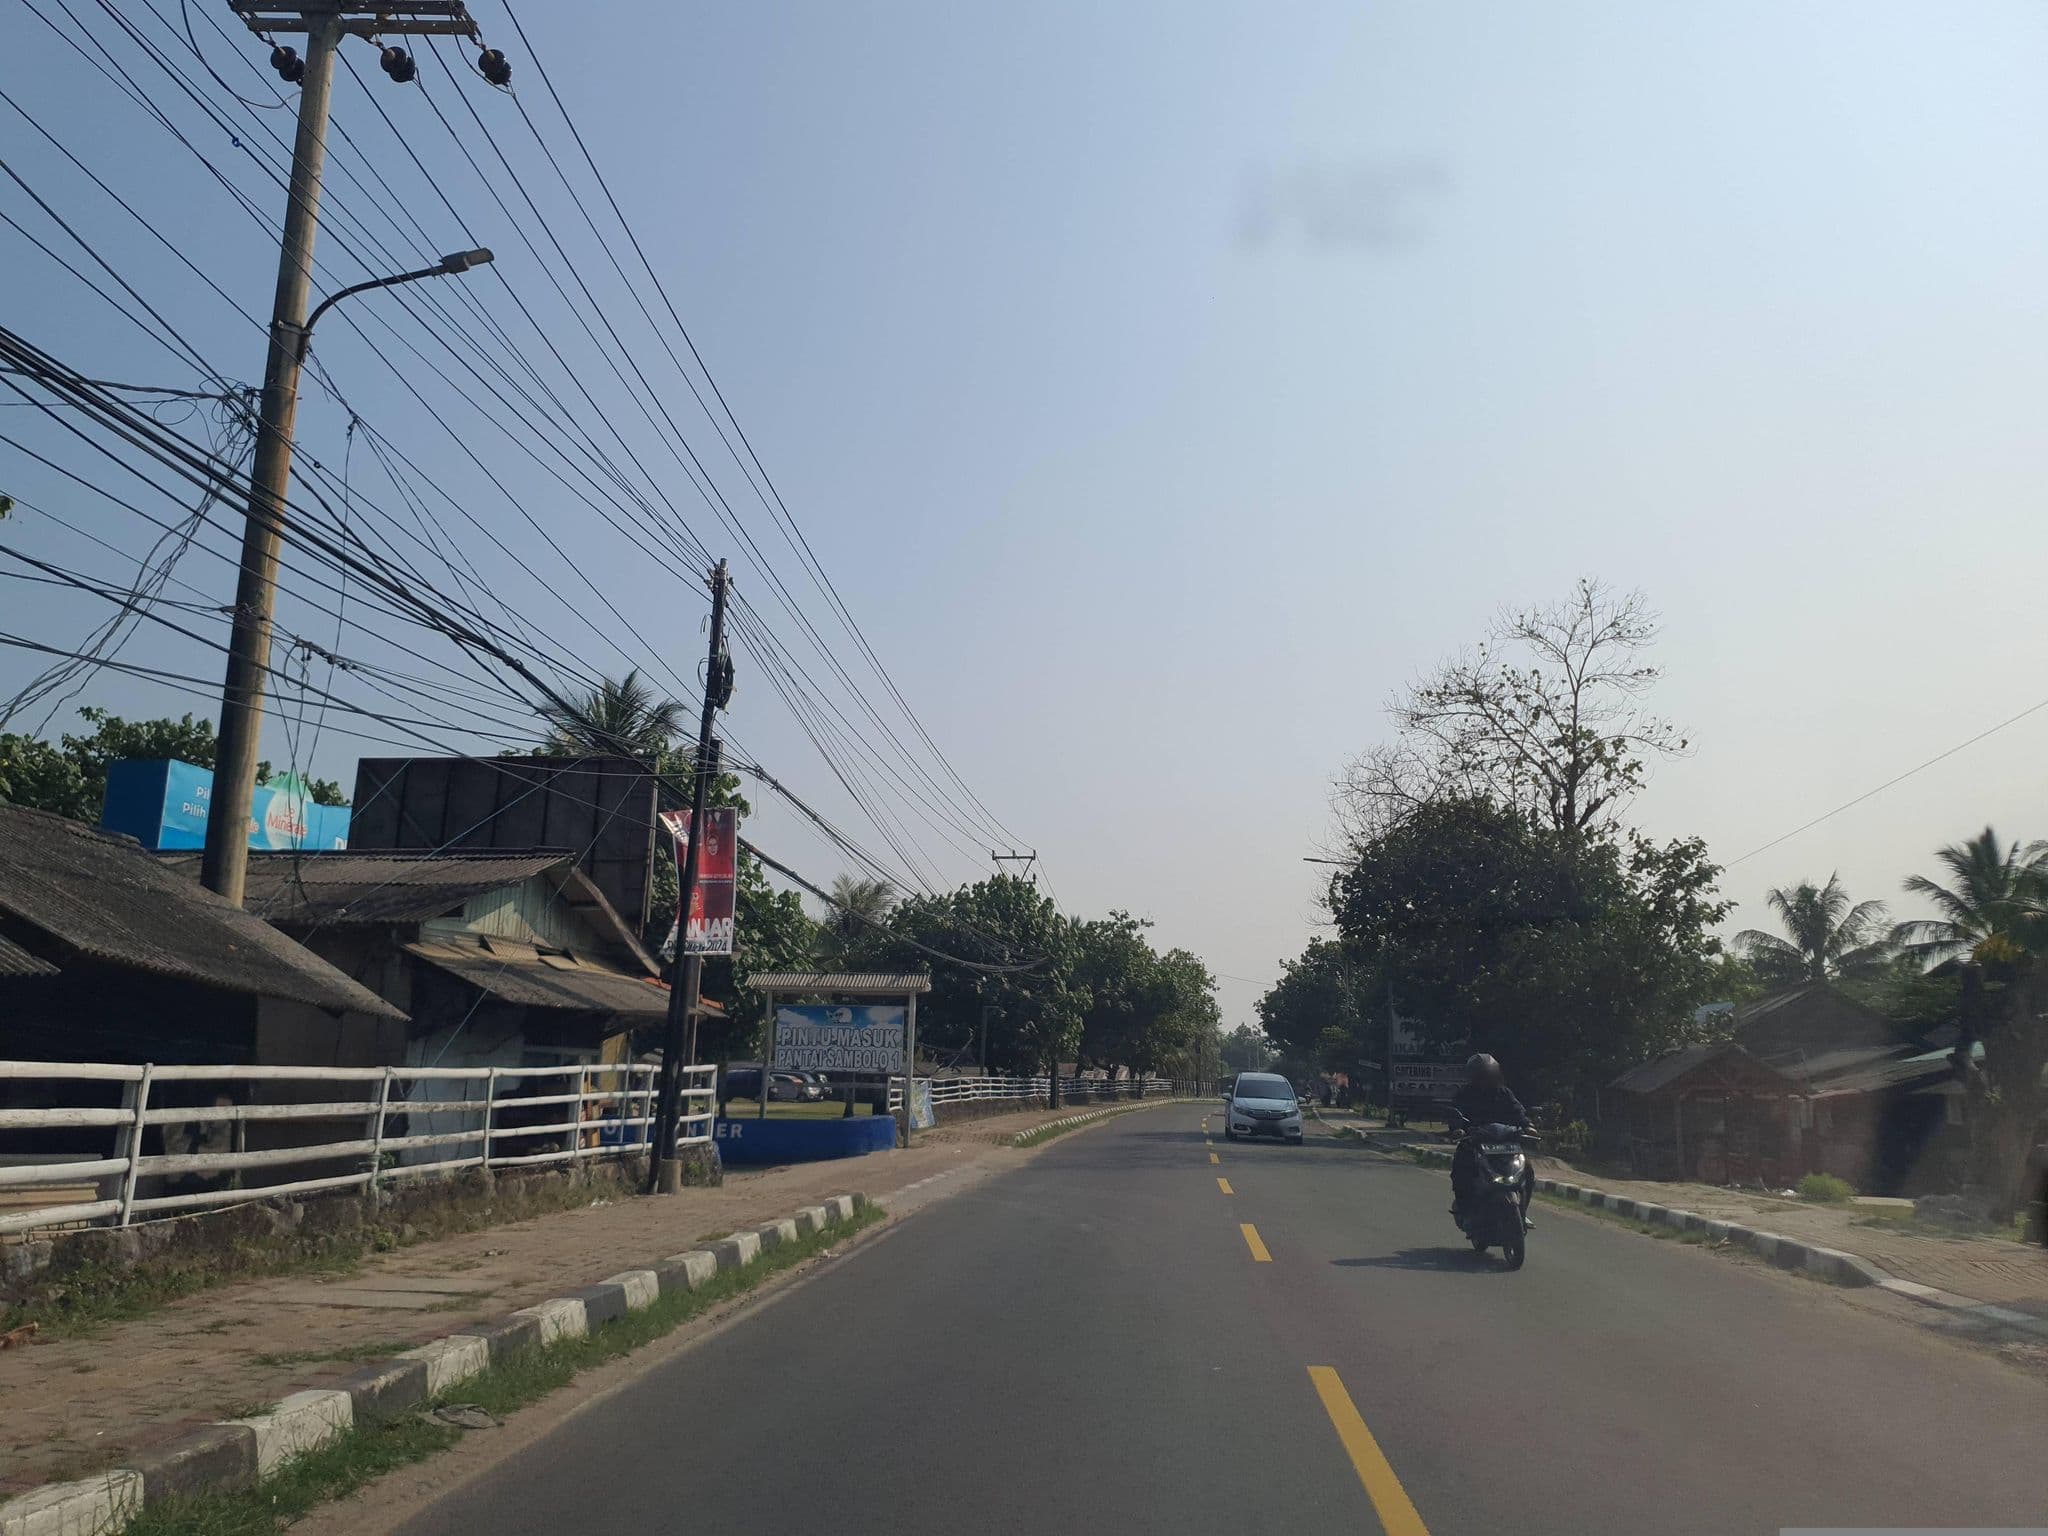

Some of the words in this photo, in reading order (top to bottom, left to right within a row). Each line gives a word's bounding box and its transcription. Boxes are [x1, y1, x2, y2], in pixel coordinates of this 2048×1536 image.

[182, 802, 207, 818] Pilih
[836, 1028, 898, 1048] MASUK
[778, 1048, 823, 1067] PANTAI
[826, 1050, 888, 1070] SAMBOLO
[892, 1050, 899, 1070] 1
